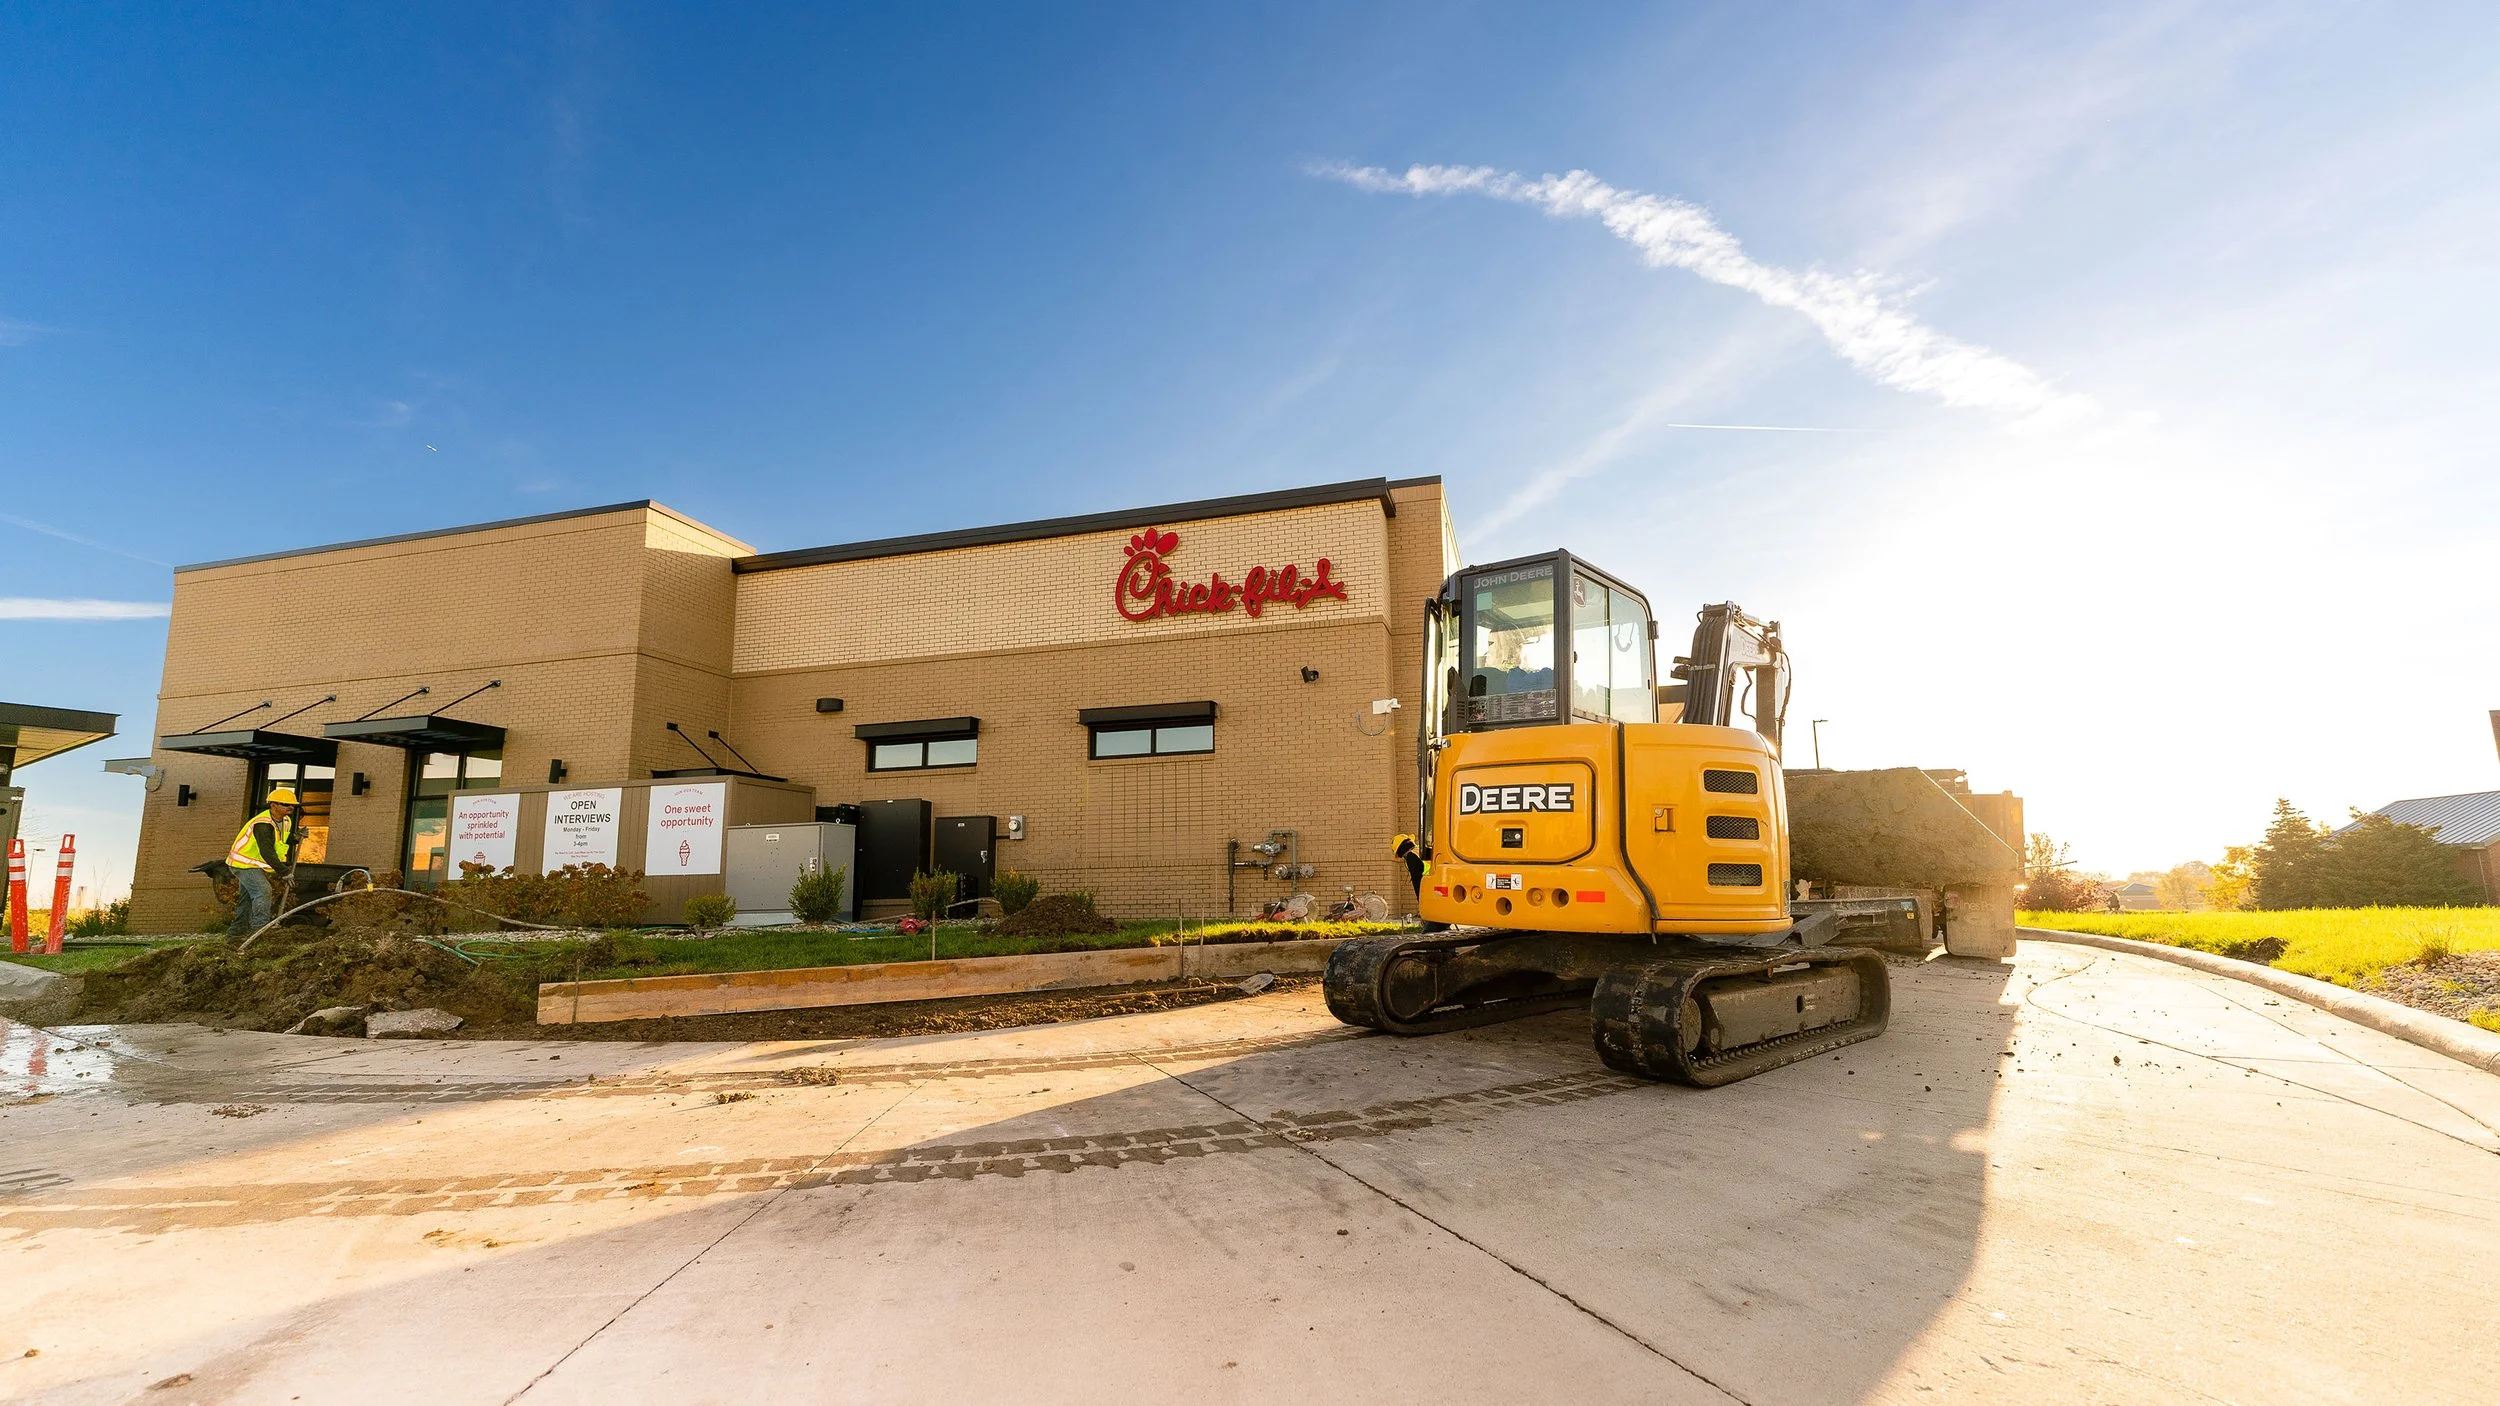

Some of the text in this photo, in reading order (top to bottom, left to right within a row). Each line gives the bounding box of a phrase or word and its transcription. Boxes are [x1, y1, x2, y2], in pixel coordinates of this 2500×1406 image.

[1474, 565, 1553, 589] JOHN DEERE
[1461, 785, 1571, 813] DEERE
[570, 800, 596, 810] OPEN
[664, 803, 711, 814] One sweet
[458, 809, 509, 820] An opportunity
[554, 813, 611, 824] INTERVIEWS
[467, 821, 498, 830] sprinkled
[660, 815, 714, 829] opportunity
[458, 831, 505, 840] with potential
